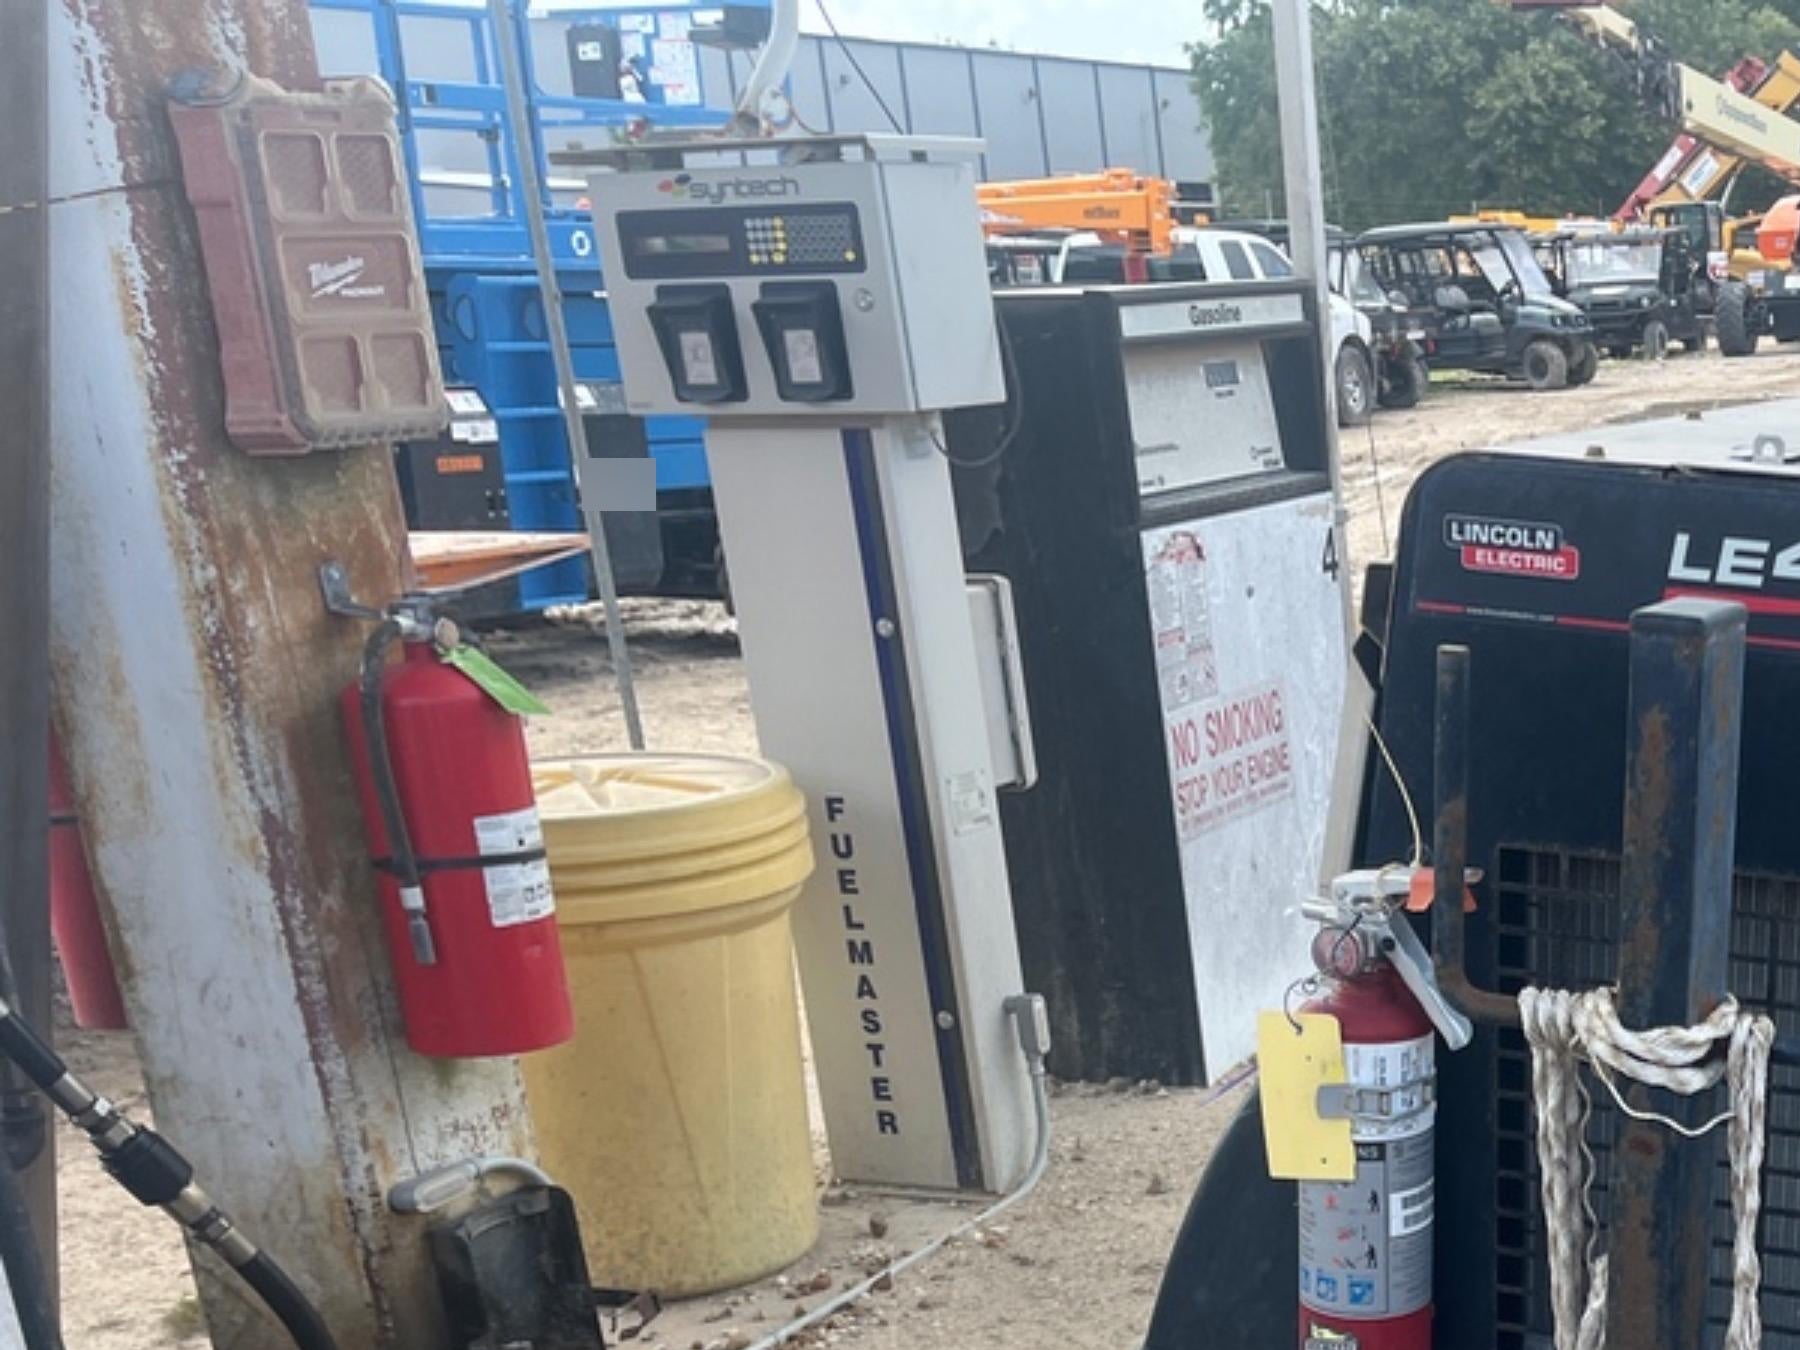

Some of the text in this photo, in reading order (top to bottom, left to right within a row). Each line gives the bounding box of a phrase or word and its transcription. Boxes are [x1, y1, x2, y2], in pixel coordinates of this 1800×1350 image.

[689, 174, 800, 204] syntech
[1188, 303, 1242, 326] Gasoline
[1322, 526, 1339, 582] 4
[1450, 520, 1555, 550] LINCOLN
[1474, 547, 1567, 573] ELECTRIC
[1170, 688, 1284, 770] NO SMOKING
[1176, 774, 1209, 815] STOP
[1210, 760, 1247, 799] YOUR
[1247, 741, 1292, 785] ENGINE
[824, 796, 900, 1135] FUELMASTER
